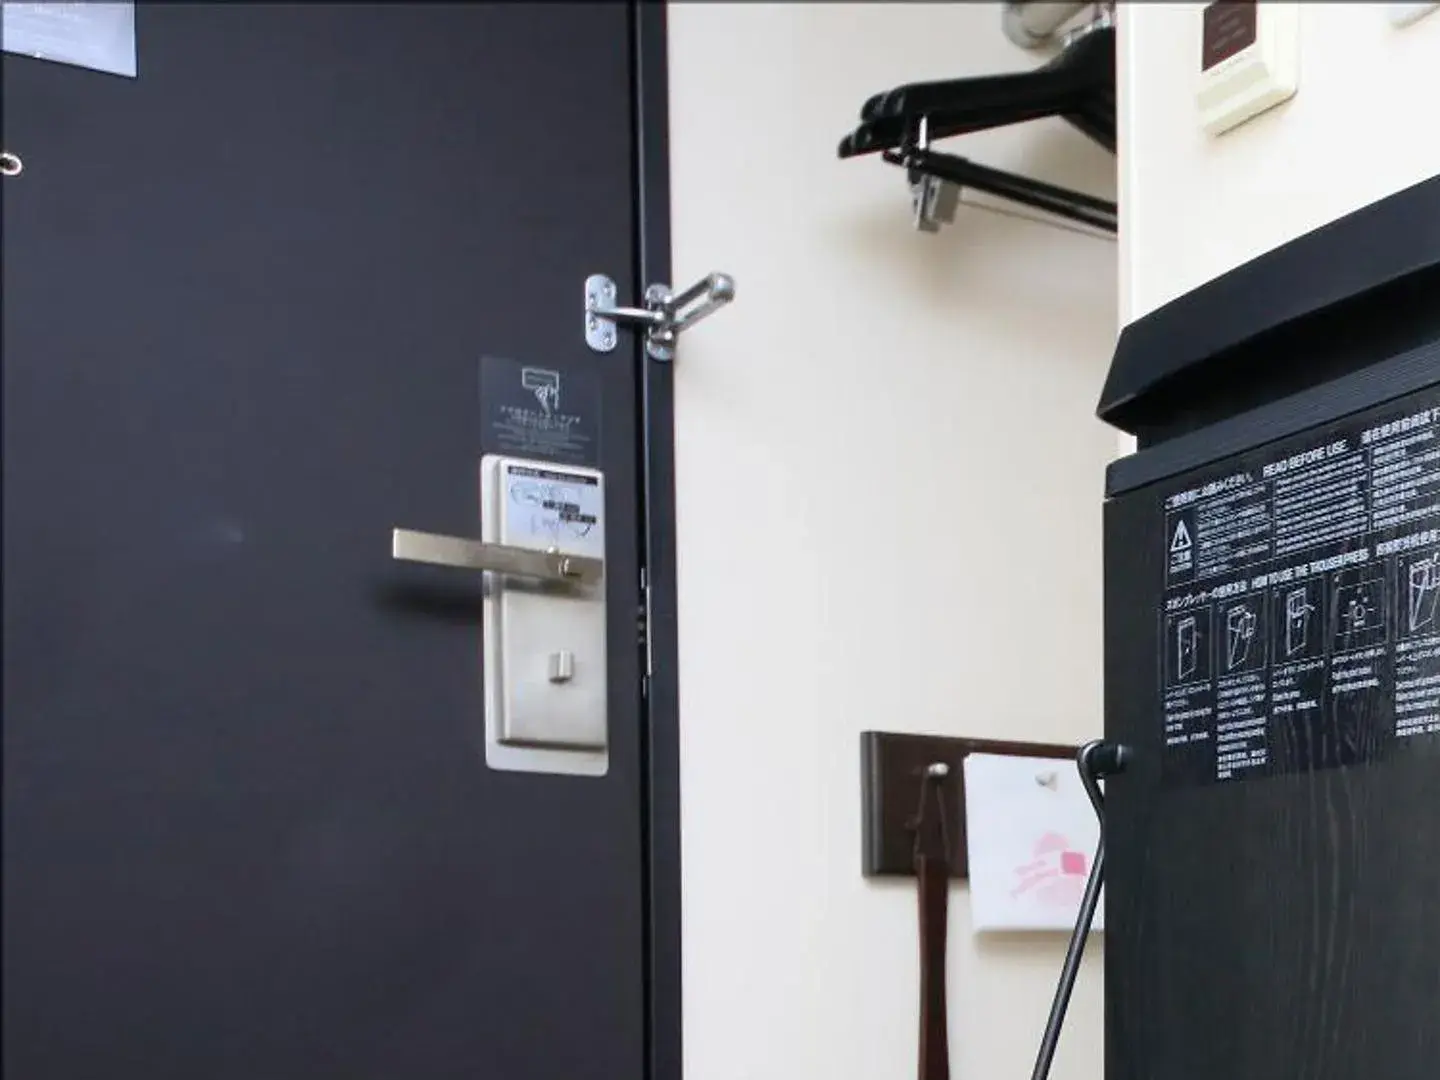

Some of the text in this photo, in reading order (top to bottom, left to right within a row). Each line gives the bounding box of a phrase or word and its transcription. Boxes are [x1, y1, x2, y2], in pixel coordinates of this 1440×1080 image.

[1263, 440, 1348, 478] READ BEFORE USE
